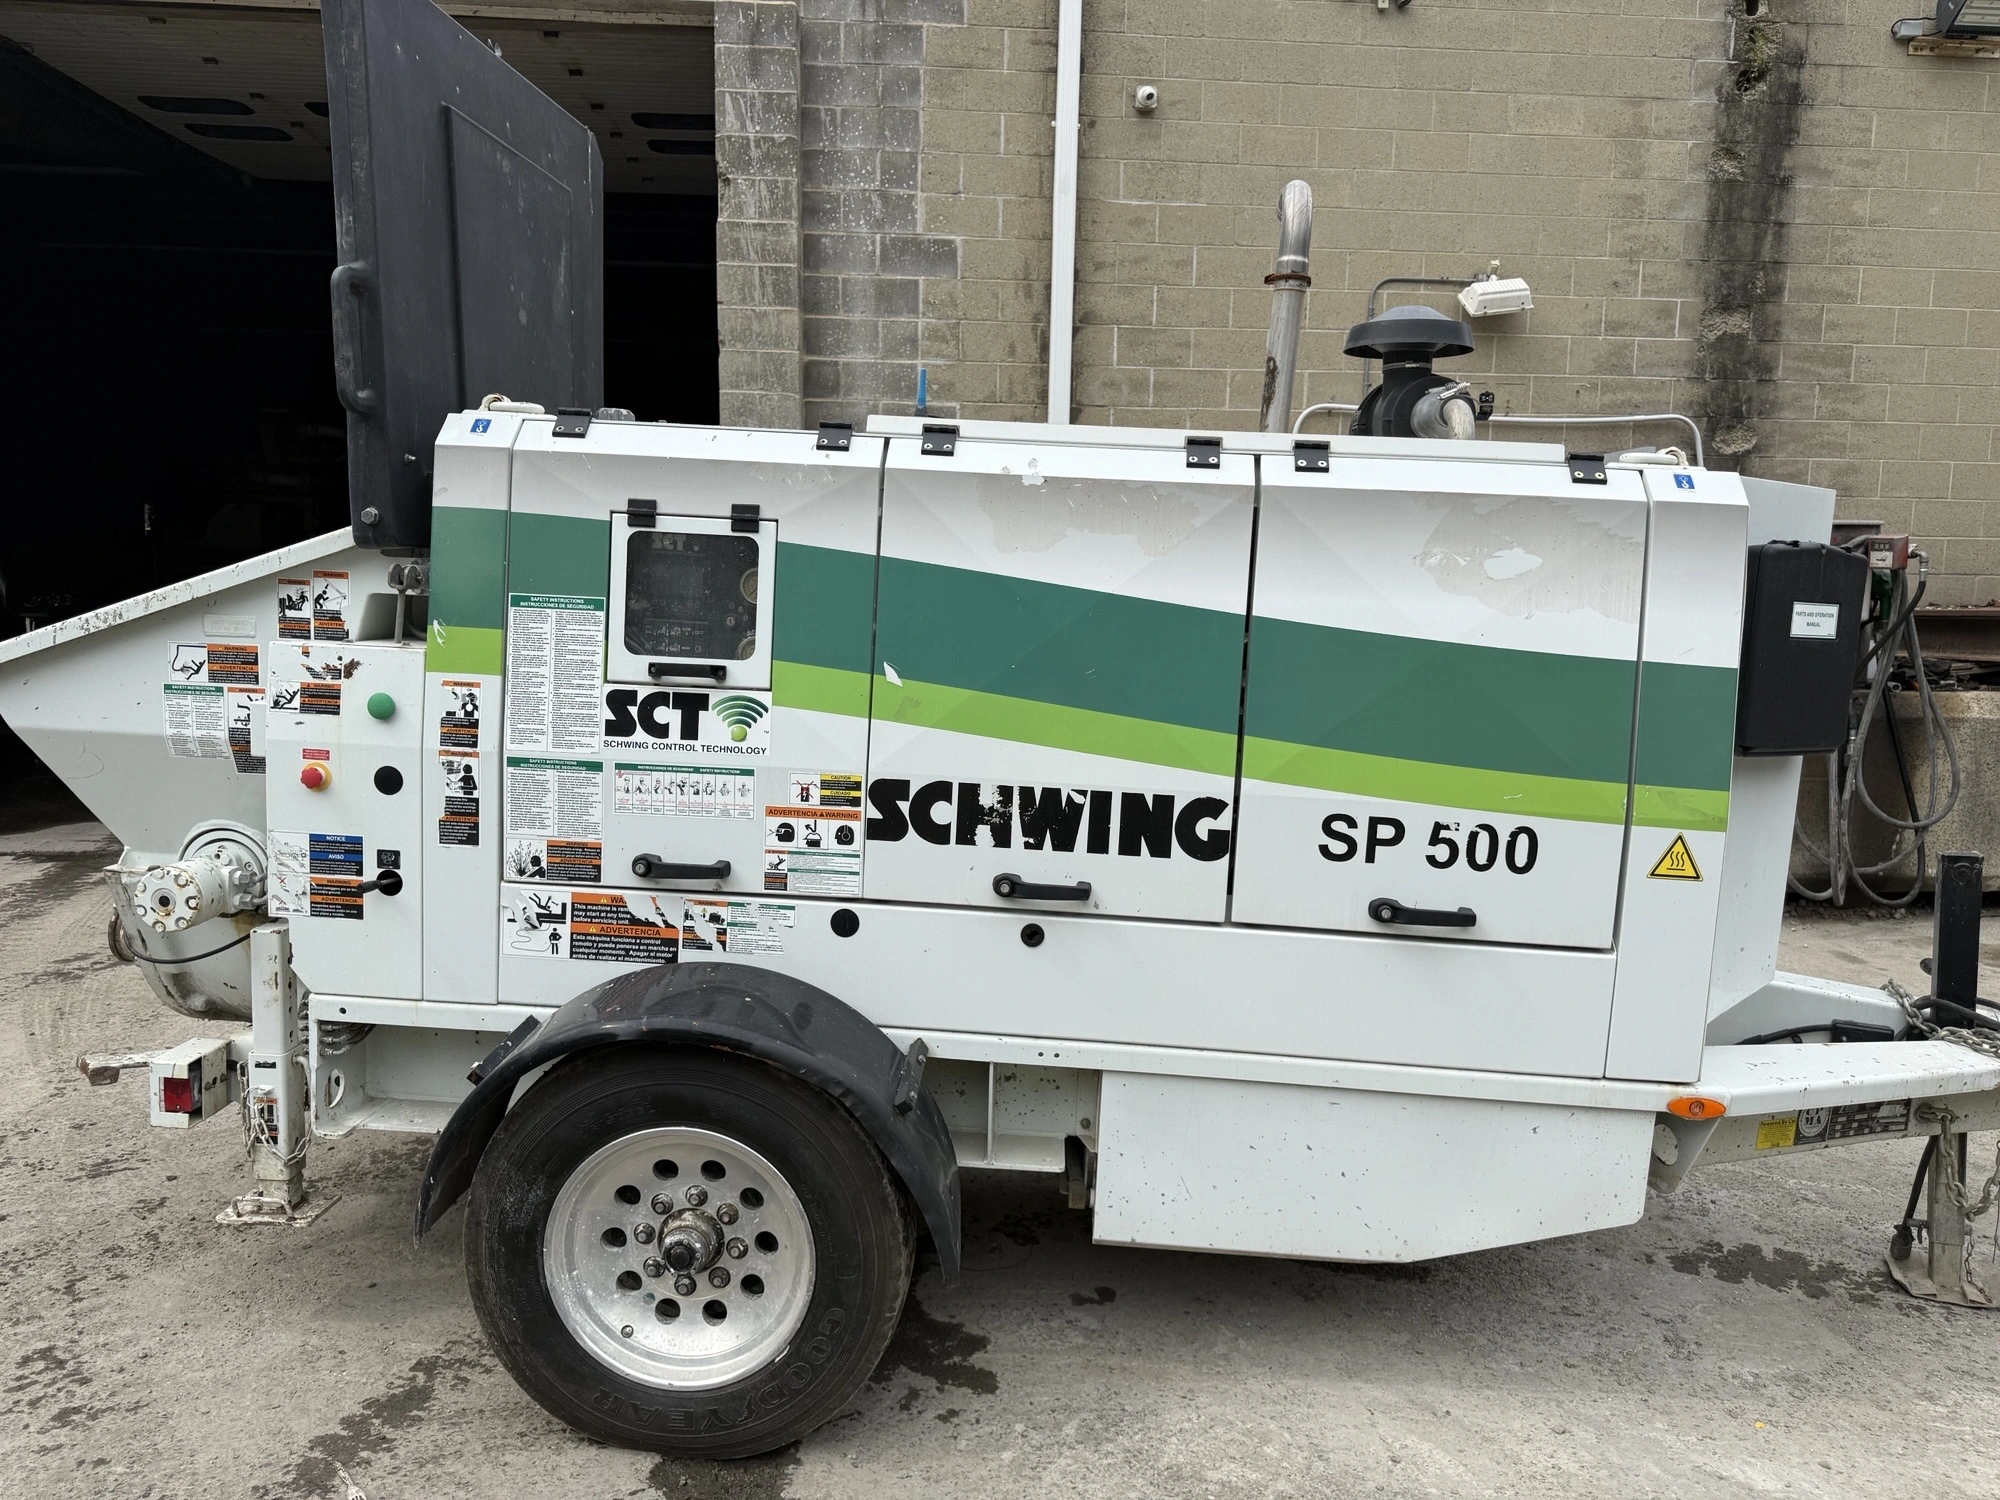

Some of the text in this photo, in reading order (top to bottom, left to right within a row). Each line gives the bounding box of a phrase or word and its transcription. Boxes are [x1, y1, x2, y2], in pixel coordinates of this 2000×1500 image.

[604, 688, 710, 741] SCT
[603, 740, 767, 755] SCHWING CONTROL TECHNOLOGY
[768, 808, 859, 820] ADVERTENCIA WARNING
[866, 778, 1231, 862] SCHWING
[1317, 813, 1539, 875] SP 500
[599, 926, 661, 936] ADVERTENCIA
[624, 956, 667, 964] mantenimiento.
[590, 1307, 846, 1431] GOODYEAR
